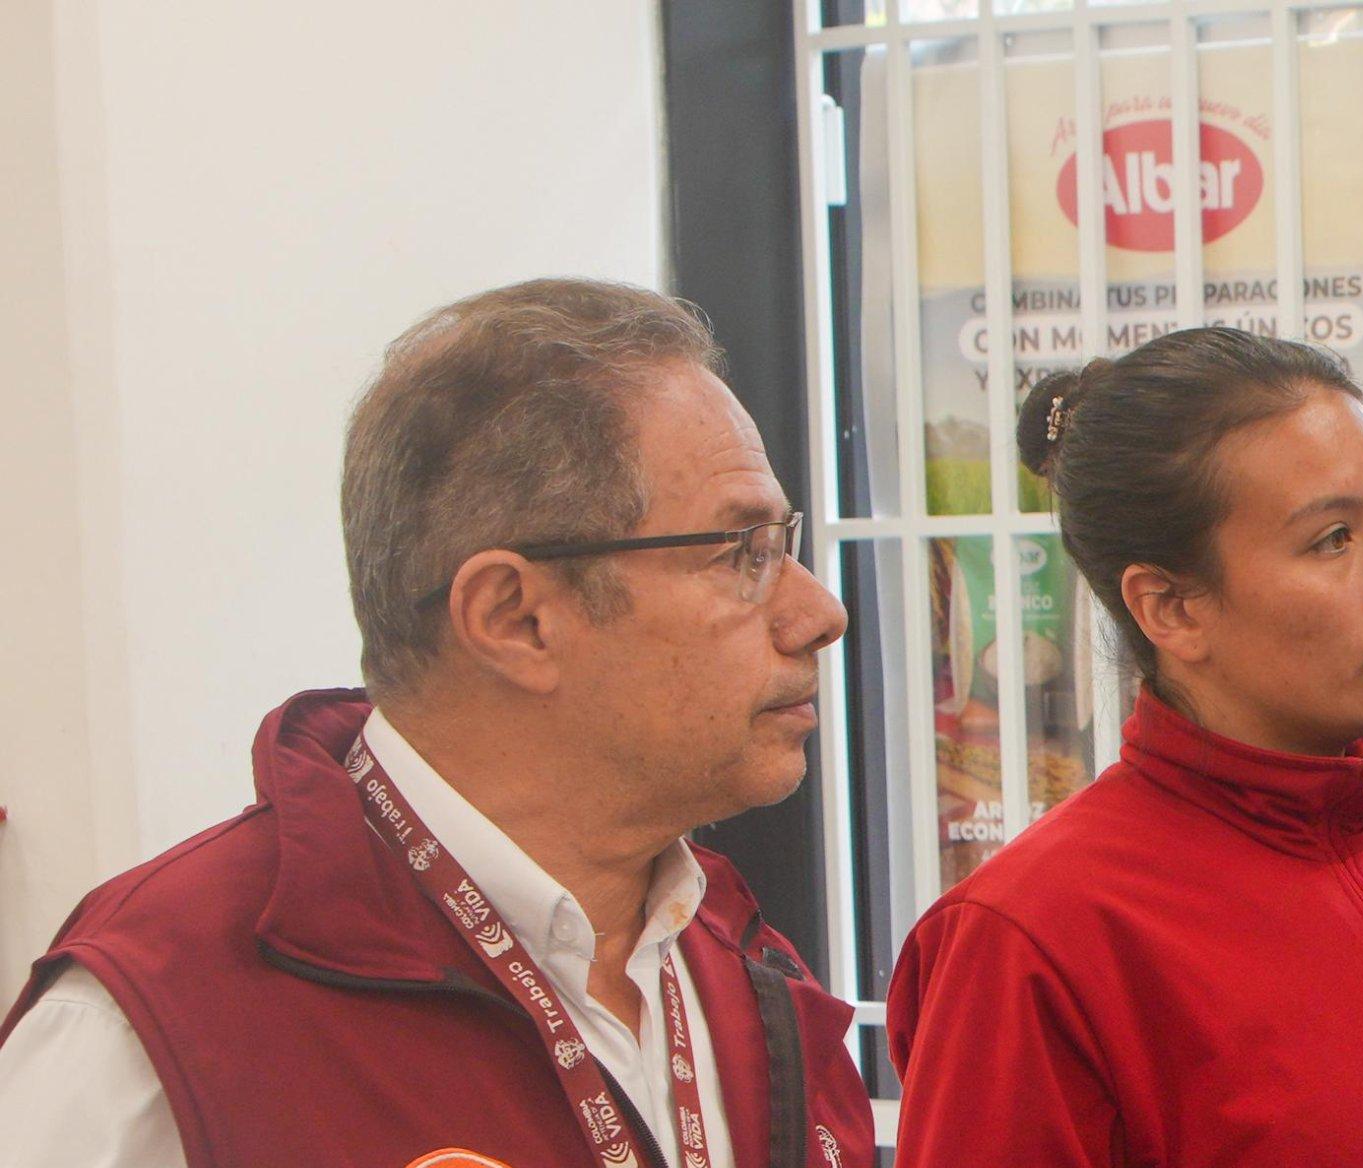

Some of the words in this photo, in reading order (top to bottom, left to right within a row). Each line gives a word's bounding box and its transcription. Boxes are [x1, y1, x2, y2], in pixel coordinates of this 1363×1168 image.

[458, 879, 490, 921] VIDA
[508, 961, 564, 1034] Trabajo
[595, 1092, 621, 1138] VIDA
